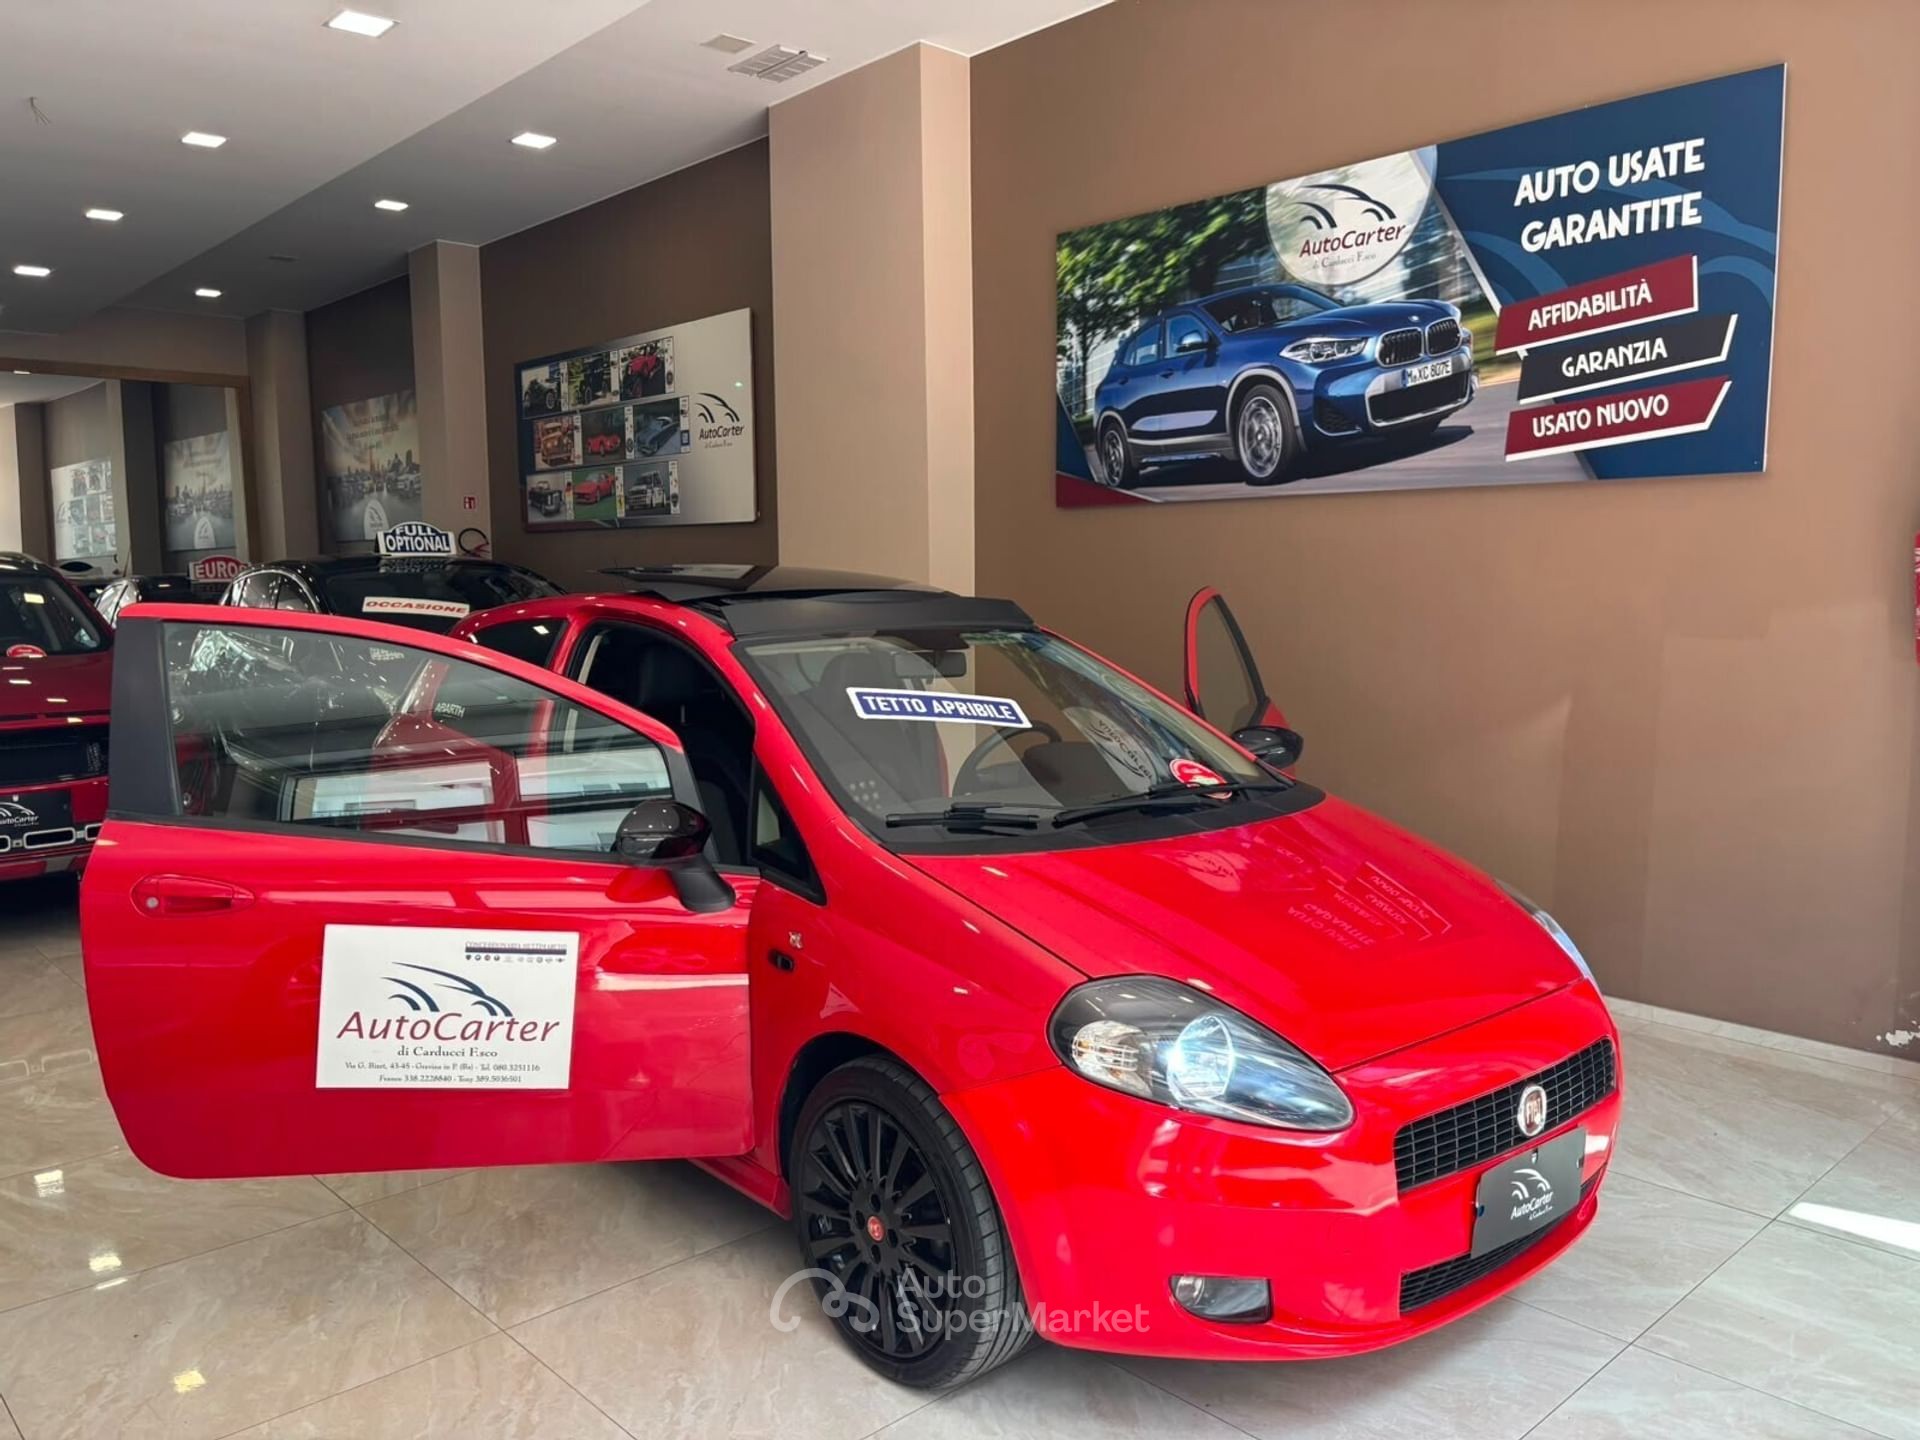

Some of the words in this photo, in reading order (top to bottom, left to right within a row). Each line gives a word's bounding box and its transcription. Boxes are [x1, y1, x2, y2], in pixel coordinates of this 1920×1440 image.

[1513, 160, 1600, 207] AUTO
[1607, 137, 1705, 187] USATE
[1520, 191, 1702, 253] GARANTITE
[1299, 224, 1406, 258] AutoCarter
[1528, 278, 1653, 331] AFFIDABILITÀ
[1561, 337, 1668, 378] GARANZIA
[1532, 408, 1592, 438] USATO
[1597, 393, 1669, 427] NUOVO
[698, 425, 745, 440] AutoCarter
[386, 534, 451, 551] OPTIONAL
[396, 525, 436, 536] FULL
[366, 601, 467, 614] OCCASIONE
[862, 695, 927, 713] TETTO
[929, 699, 1017, 720] APRIBILE
[336, 1011, 560, 1042] AutoCarter
[397, 1045, 410, 1057] di
[413, 1045, 466, 1057] Carducci
[1510, 1191, 1555, 1220] AutoCarter
